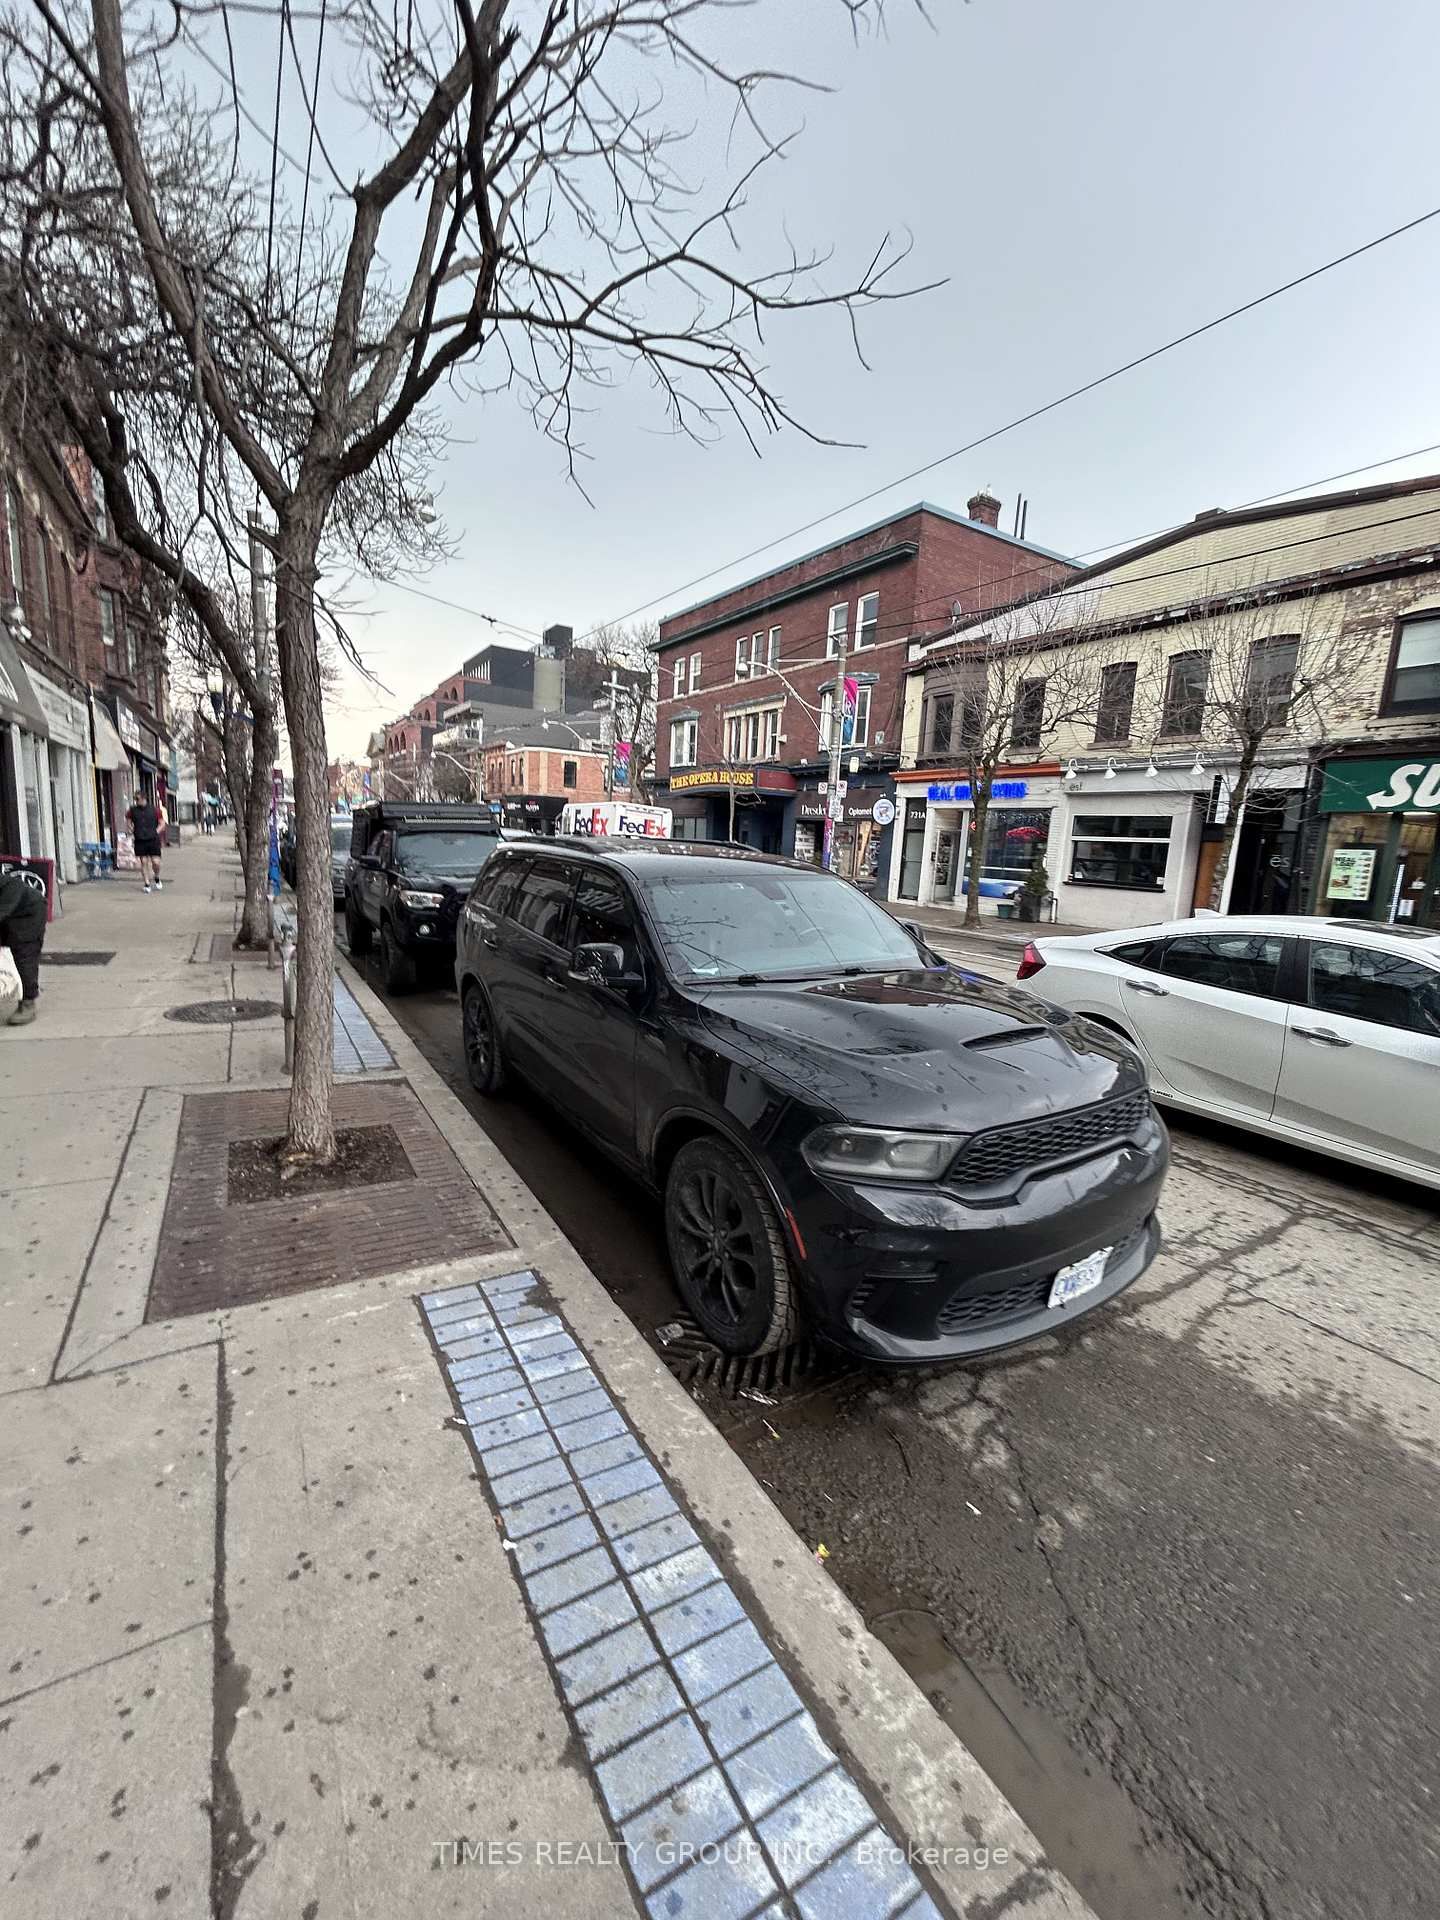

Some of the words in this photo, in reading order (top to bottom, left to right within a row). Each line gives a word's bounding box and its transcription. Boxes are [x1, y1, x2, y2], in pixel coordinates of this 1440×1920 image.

[672, 774, 689, 789] THE
[688, 771, 719, 786] OPERA
[719, 771, 754, 786] HOUSE
[574, 808, 609, 837] FedEx
[619, 815, 668, 838] FedEx
